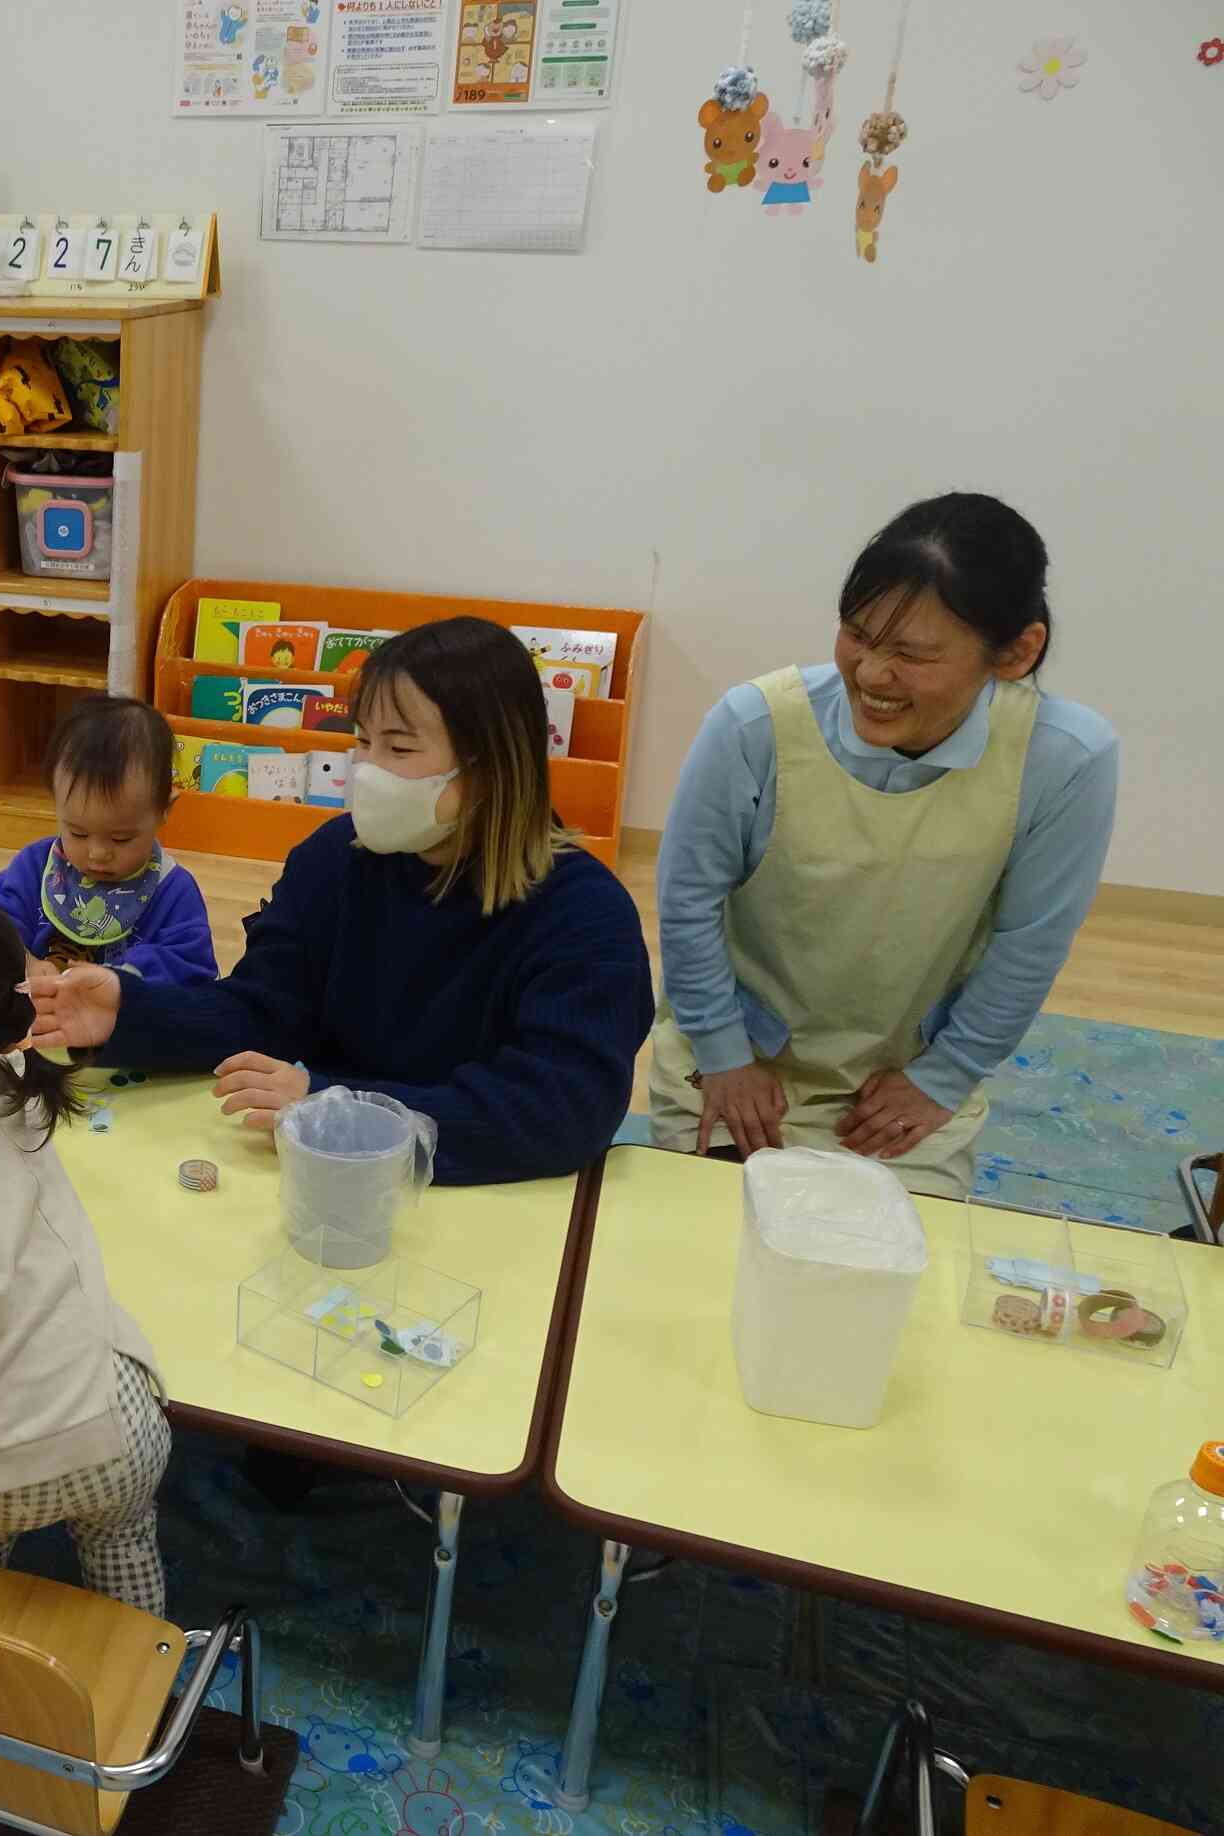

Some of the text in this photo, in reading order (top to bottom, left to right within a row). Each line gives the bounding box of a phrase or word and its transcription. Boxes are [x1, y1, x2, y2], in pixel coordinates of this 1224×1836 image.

[464, 89, 486, 101] 189
[8, 237, 112, 270] 2 2 7
[125, 233, 145, 273] きん
[247, 690, 304, 715] おつきさまこん
